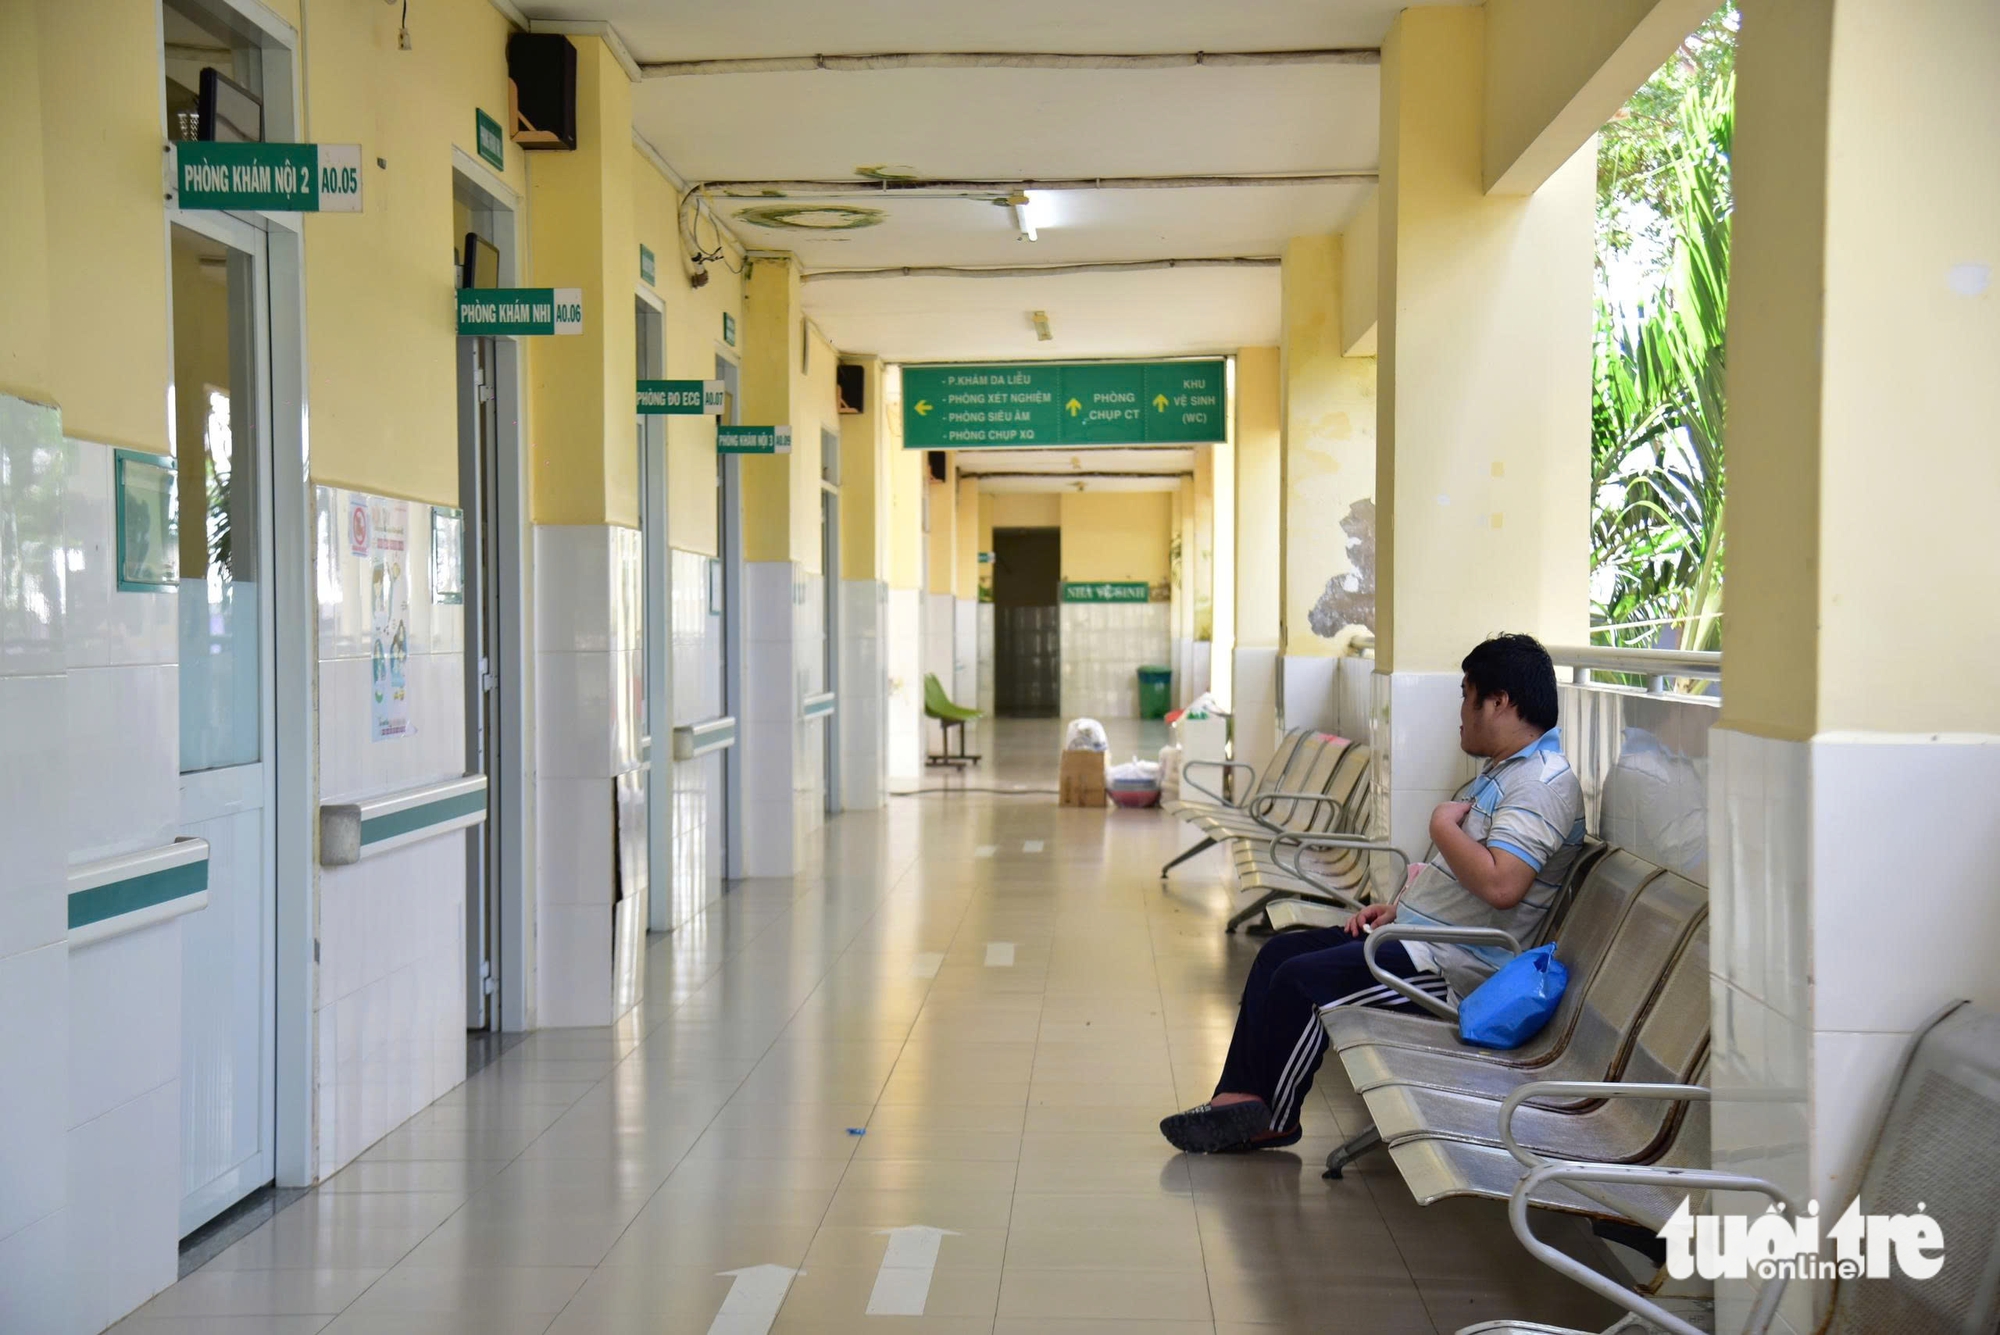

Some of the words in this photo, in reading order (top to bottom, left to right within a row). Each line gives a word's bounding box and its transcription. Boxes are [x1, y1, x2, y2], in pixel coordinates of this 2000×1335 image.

[184, 157, 230, 193] PHÒNG
[232, 158, 271, 193] KHÁM
[274, 159, 297, 200] NỘI
[301, 166, 310, 194] 2
[321, 167, 357, 194] A0.05
[461, 299, 496, 323] PHÒNG
[499, 299, 530, 323] KHÁM
[532, 303, 551, 323] NHI
[556, 304, 581, 323] A0.06
[948, 374, 988, 386] P.KHÁM
[990, 375, 1005, 385] DA
[1183, 379, 1206, 389] KHU
[637, 388, 666, 406] PHÒNG
[668, 391, 681, 406] ĐO
[682, 391, 700, 406] ECG
[948, 391, 985, 404] PHÒNG
[1010, 390, 1051, 404] NGHIỆM
[1093, 391, 1135, 404] PHÒNG
[1173, 394, 1188, 408] VỆ
[1190, 395, 1216, 406] SINH
[949, 409, 985, 422] PHÒNG
[987, 409, 1012, 422] SIÊU
[1089, 410, 1122, 422] CHỤP
[1124, 409, 1140, 420] CT
[1182, 413, 1207, 424] (WC)
[949, 428, 986, 441] PHÒNG
[988, 430, 1017, 442] CHỤP
[1019, 429, 1035, 440] XQ
